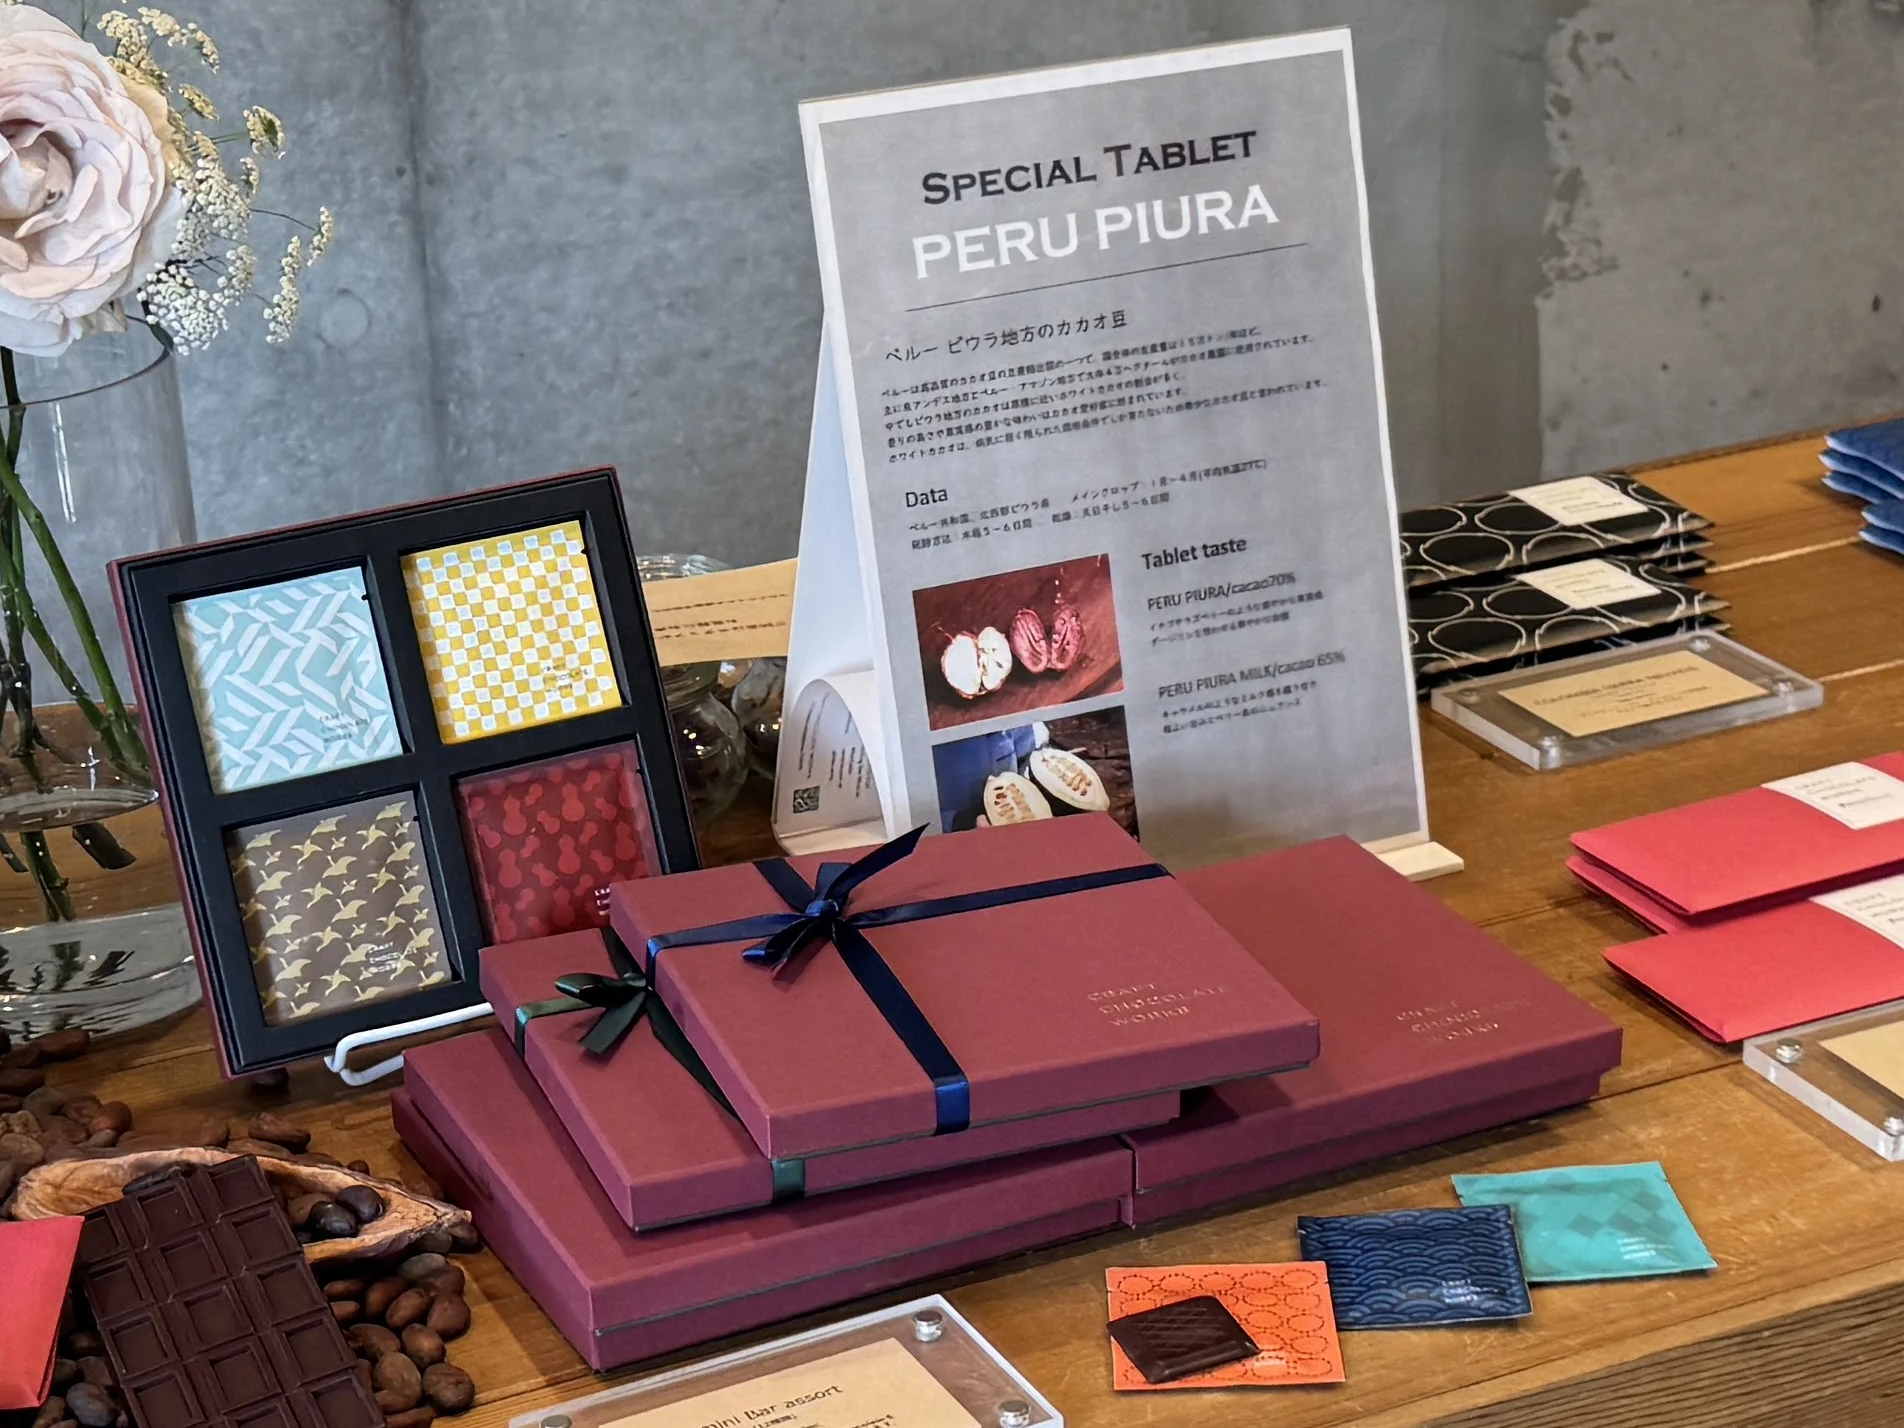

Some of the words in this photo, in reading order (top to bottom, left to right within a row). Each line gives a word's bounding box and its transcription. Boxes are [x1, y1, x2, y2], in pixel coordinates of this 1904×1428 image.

[923, 156, 1097, 205] SPECIAL
[1104, 132, 1257, 177] TABLET
[911, 212, 1078, 279] PERU
[1096, 185, 1279, 250] PIURA
[905, 488, 948, 508] Data
[1141, 546, 1198, 570] Tablet
[1203, 538, 1247, 559] taste
[1147, 594, 1182, 611] PERU
[1158, 681, 1193, 699] PERU
[1197, 673, 1237, 692] PIURA
[744, 1404, 778, 1421] Bar
[784, 1385, 843, 1409] assort
